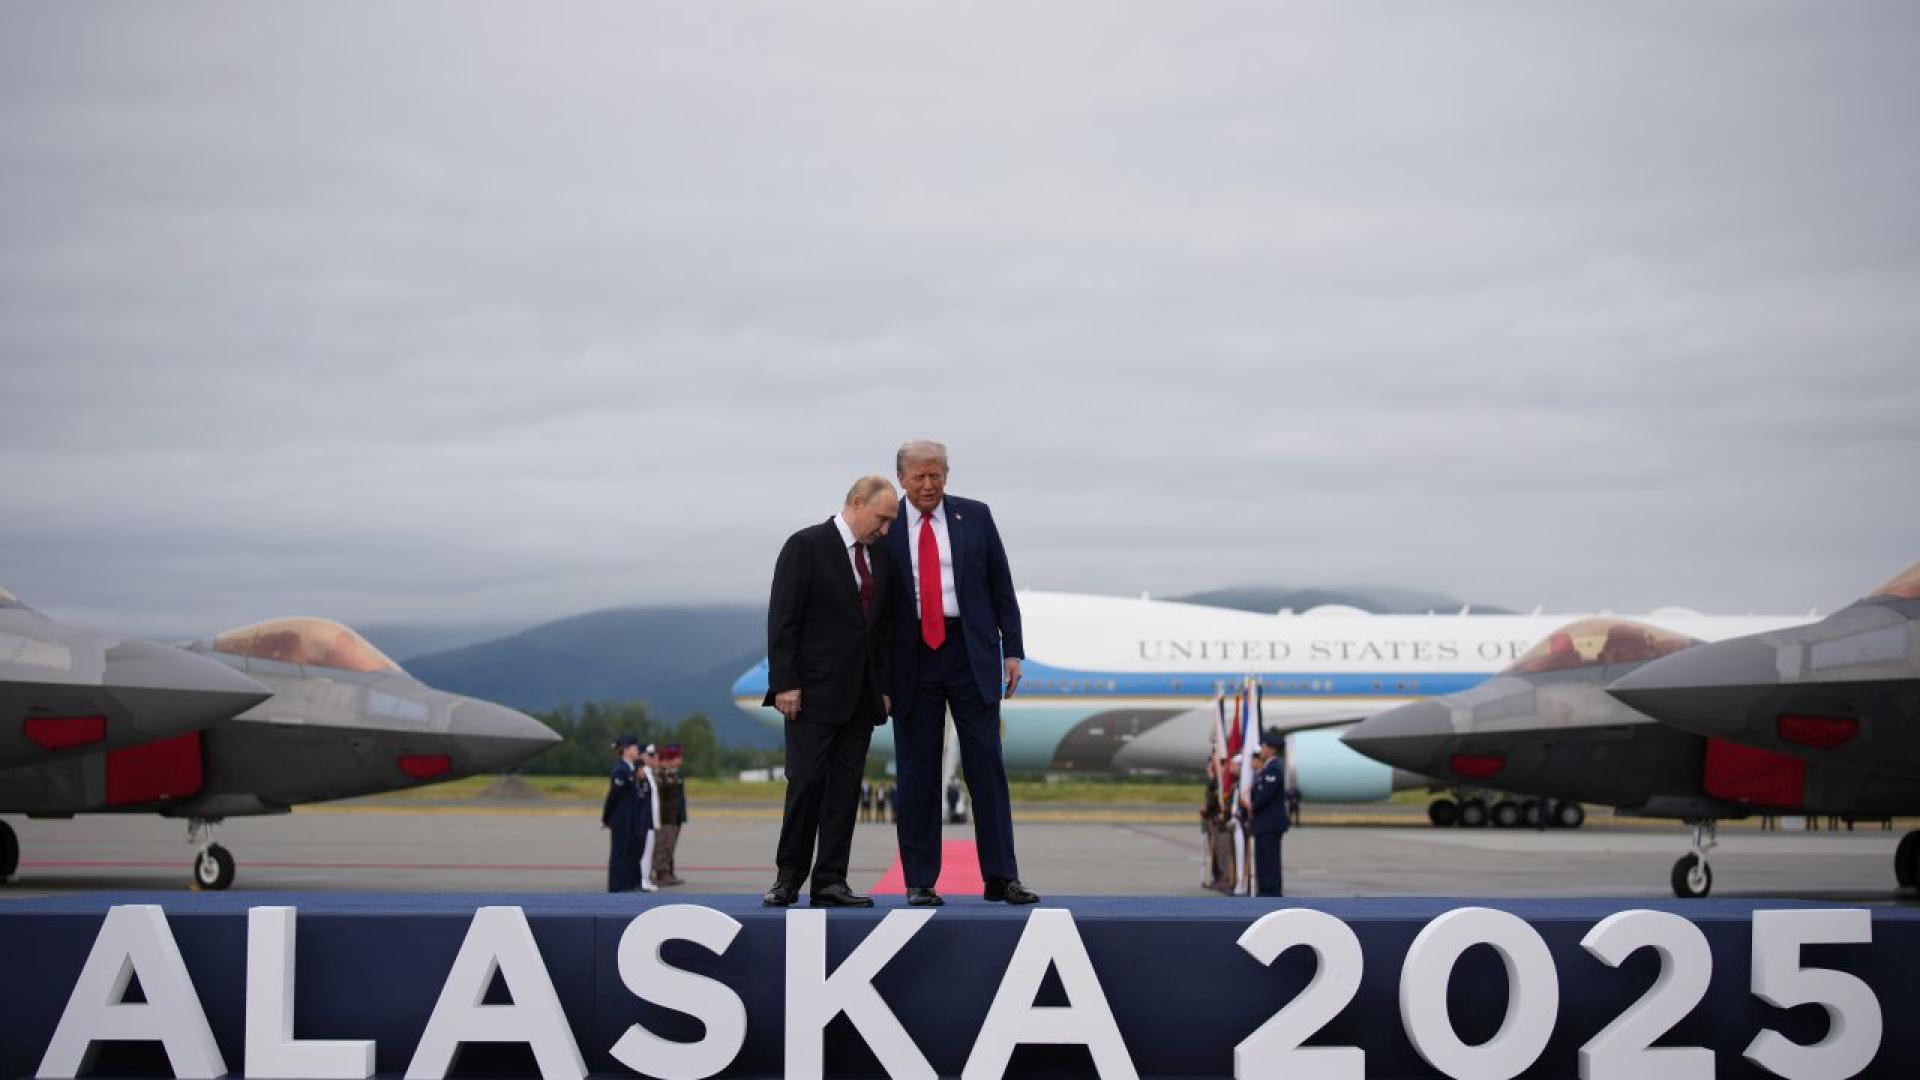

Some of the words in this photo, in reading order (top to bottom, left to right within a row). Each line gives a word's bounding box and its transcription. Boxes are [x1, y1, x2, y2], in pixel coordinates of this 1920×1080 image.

[1137, 639, 1291, 661] UNITED
[1309, 639, 1461, 661] STATES
[1477, 640, 1527, 661] OF
[36, 904, 1139, 1080] ALASKA
[1233, 906, 1883, 1080] 2025
